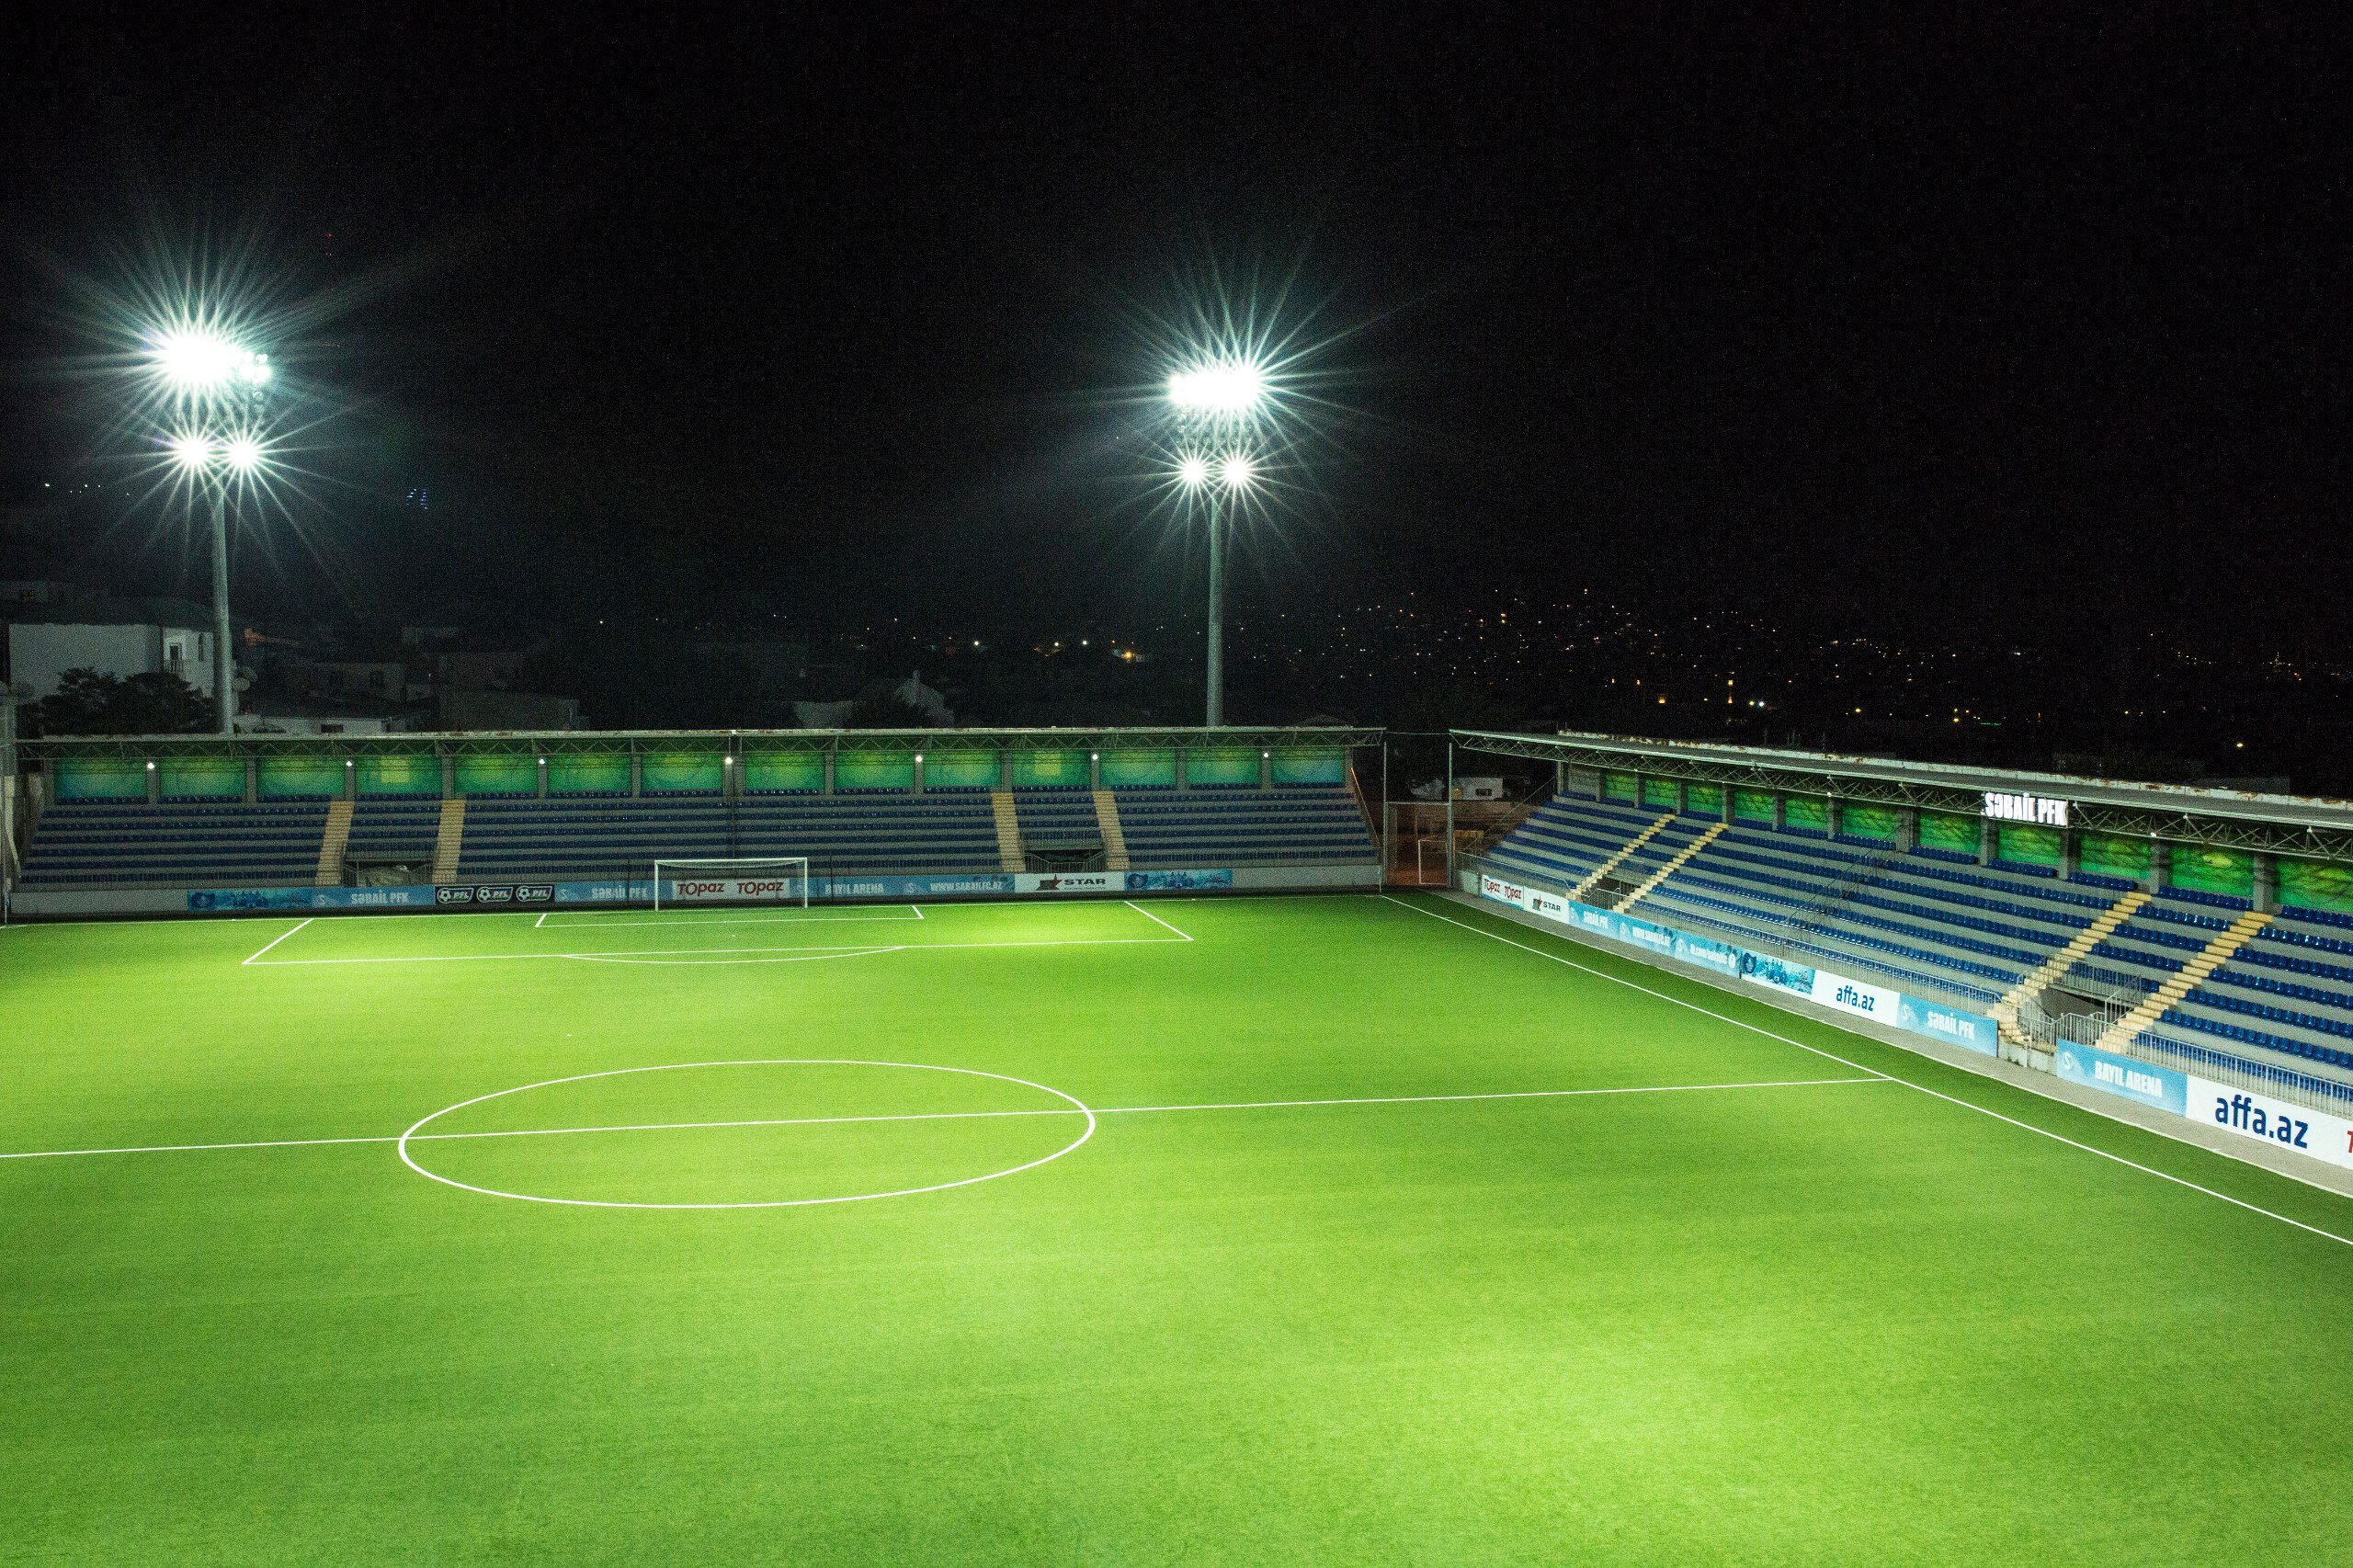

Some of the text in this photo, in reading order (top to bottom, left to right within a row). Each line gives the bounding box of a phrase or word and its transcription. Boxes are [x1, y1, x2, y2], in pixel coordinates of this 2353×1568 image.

[1985, 792, 2068, 826] SƏBAİL PFK
[1543, 902, 1561, 912] STAR
[1836, 985, 1875, 1011] affa.az
[1959, 1021, 1975, 1040] PFK
[2096, 1061, 2125, 1086] BAYIL
[2126, 1070, 2163, 1097] ARENA
[2215, 1094, 2308, 1149] affa.az
